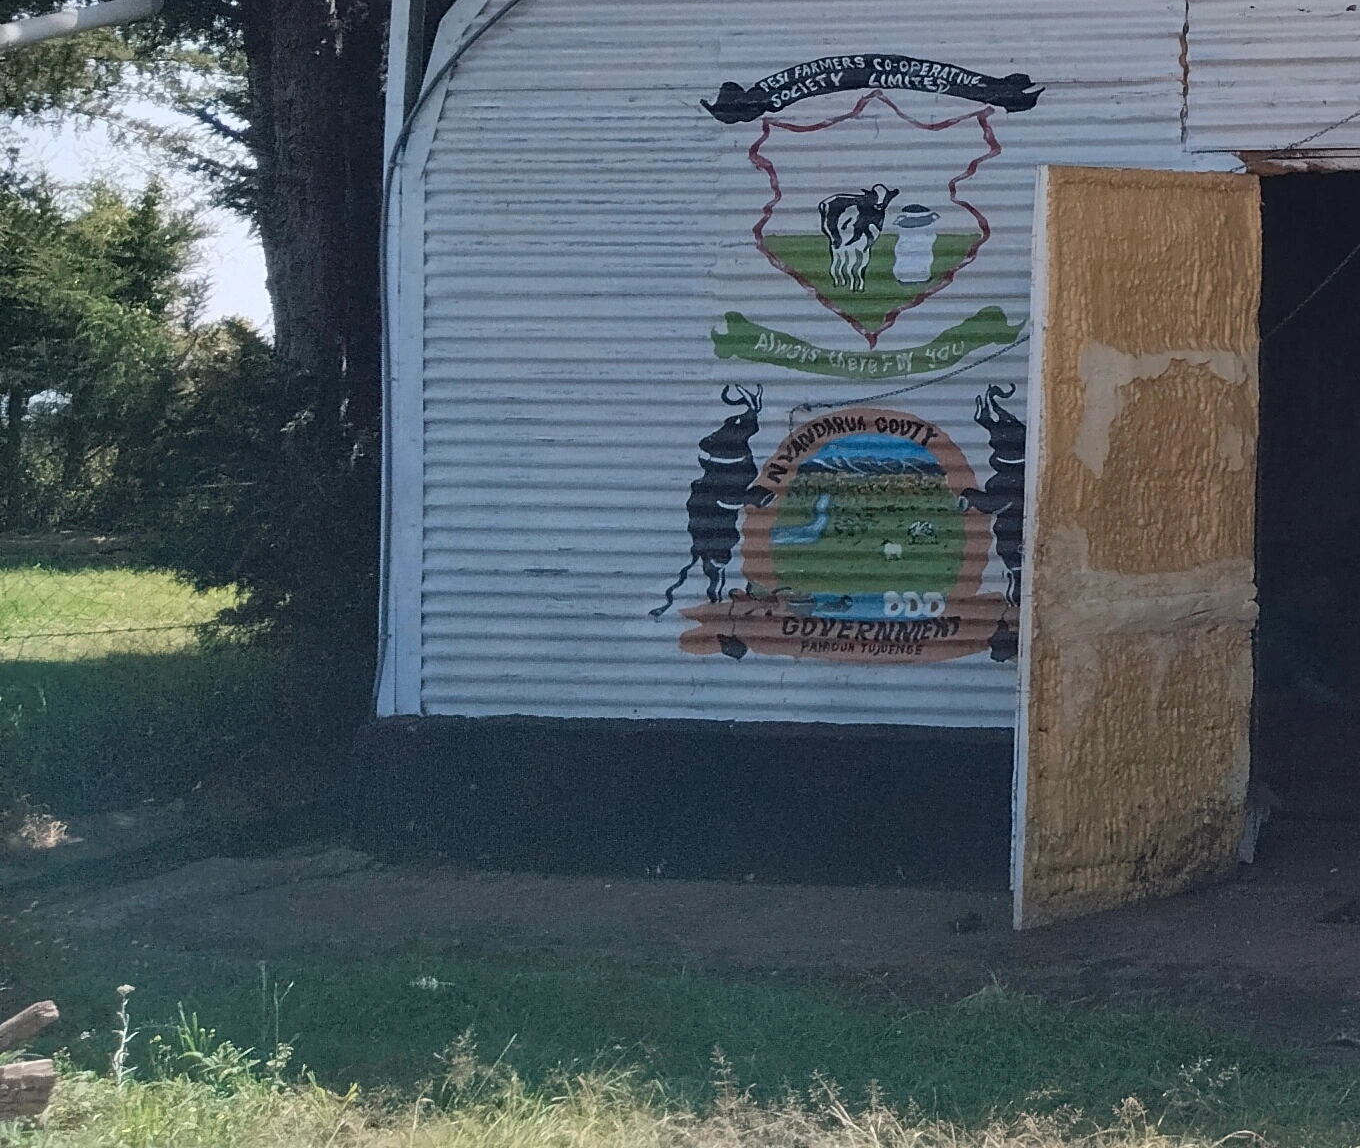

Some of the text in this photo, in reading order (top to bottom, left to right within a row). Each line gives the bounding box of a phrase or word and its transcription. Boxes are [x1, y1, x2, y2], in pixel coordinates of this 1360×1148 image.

[760, 56, 987, 92] PESI FARMERS CO-OPERATIVE
[771, 71, 950, 108] SOCIETY LIMITED
[754, 332, 817, 363] Always
[829, 350, 877, 374] there
[767, 415, 867, 484] NYANDARUA
